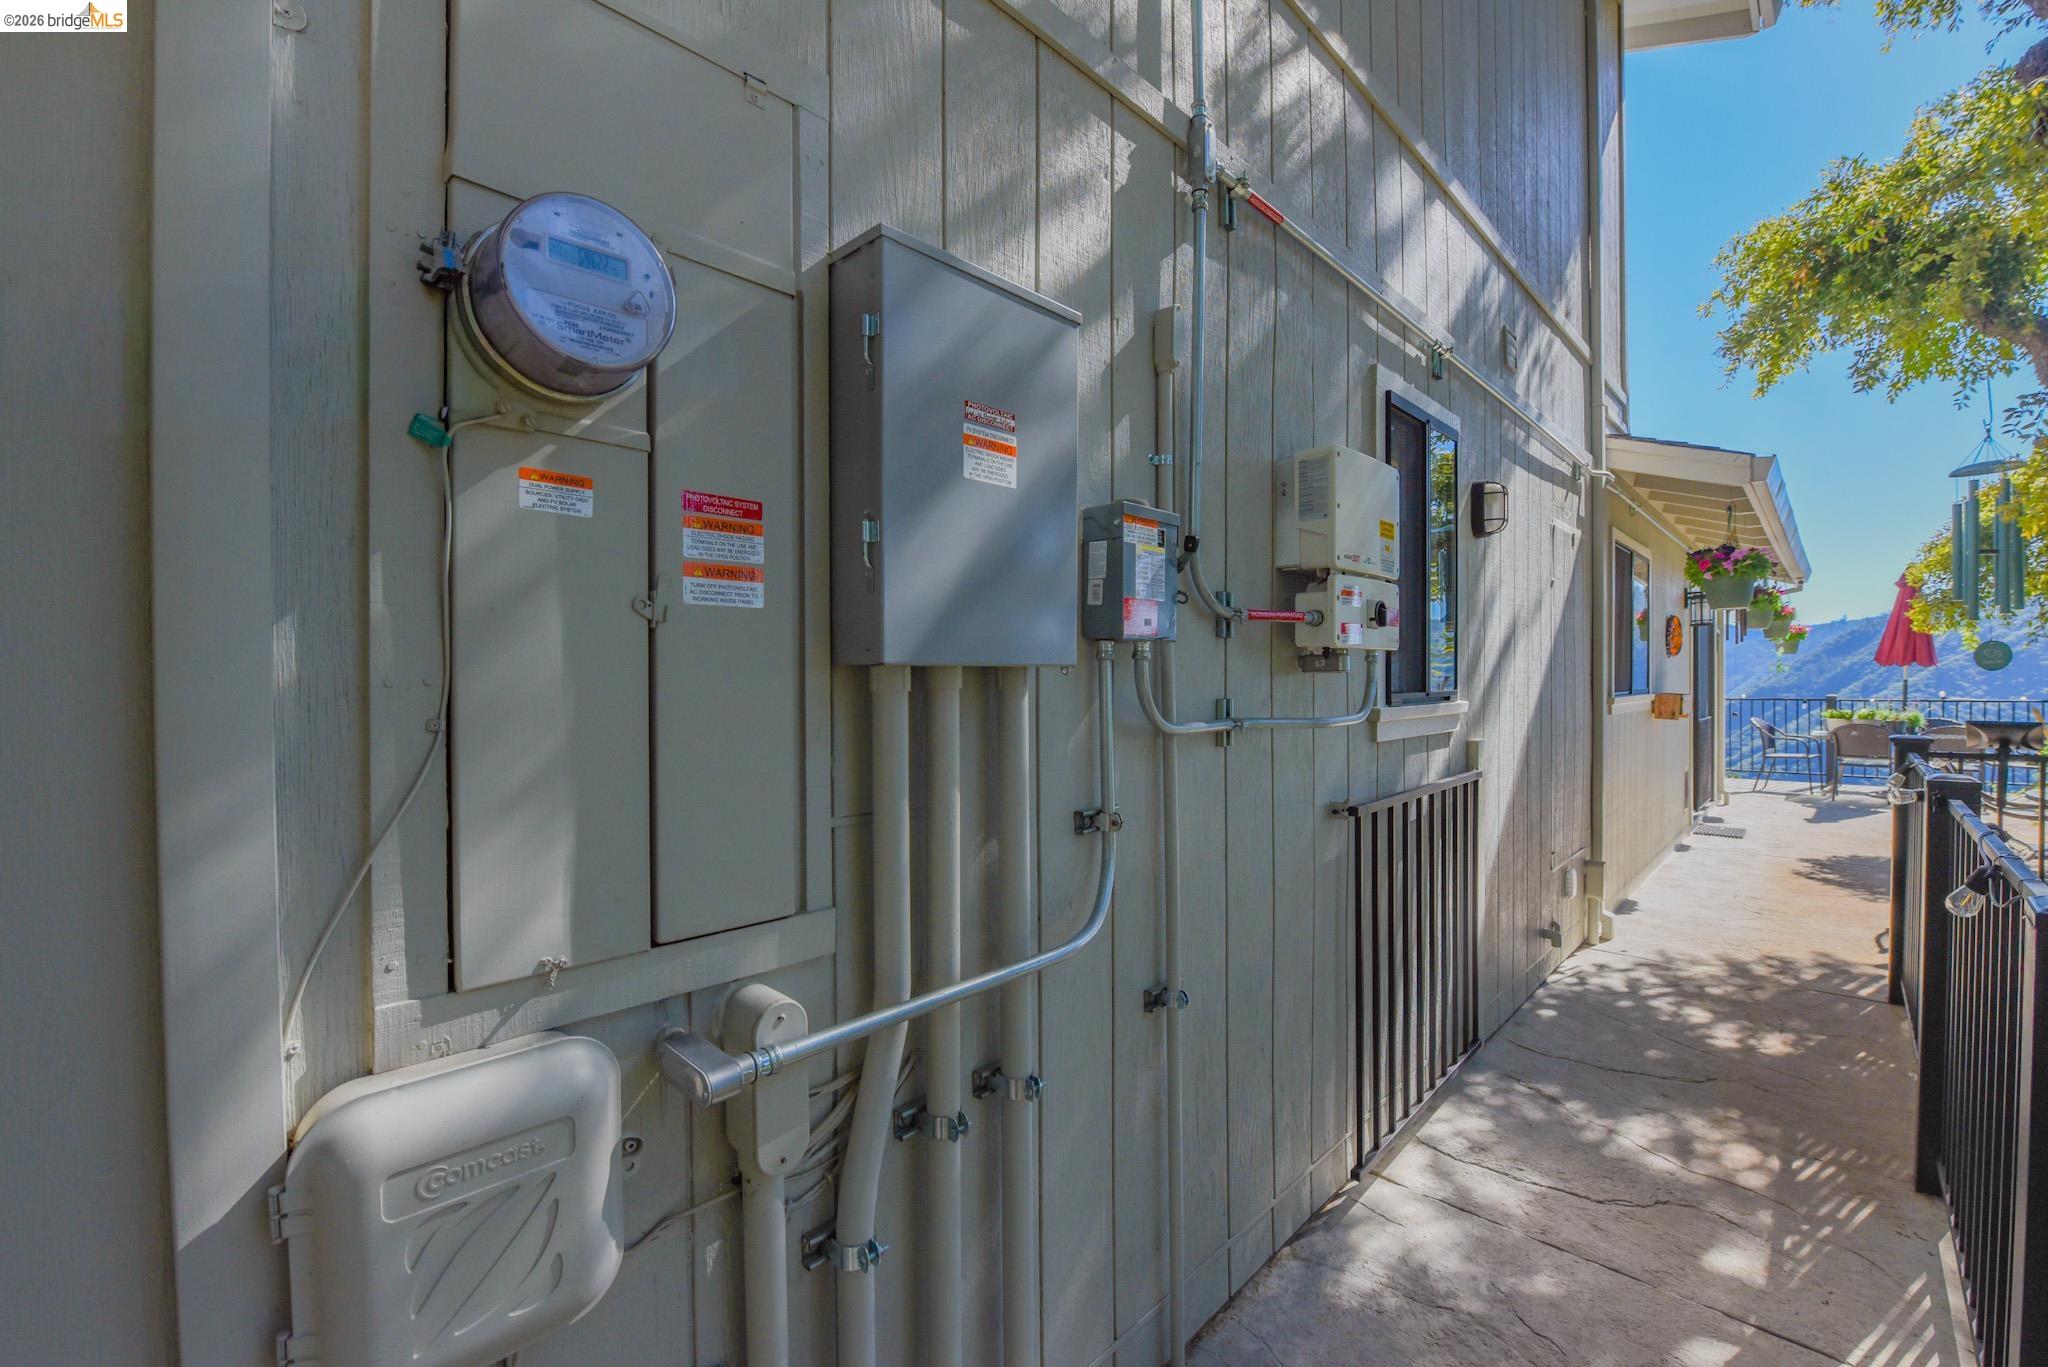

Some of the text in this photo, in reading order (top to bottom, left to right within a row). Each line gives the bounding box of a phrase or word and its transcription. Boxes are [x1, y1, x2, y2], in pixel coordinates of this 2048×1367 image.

[557, 321, 624, 346] SmartMeter
[967, 401, 1012, 419] PHOTOVOLTAIC
[976, 416, 1012, 431] DISCONNECT
[975, 437, 1011, 455] WARNING
[541, 473, 584, 487] WARNING
[686, 493, 758, 510] PHOTOVOLTAIC SYSTEM
[703, 505, 743, 517] DISCONNECT
[703, 520, 754, 534] WARNING
[704, 567, 755, 580] WARNING
[415, 1137, 546, 1201] Comcast
